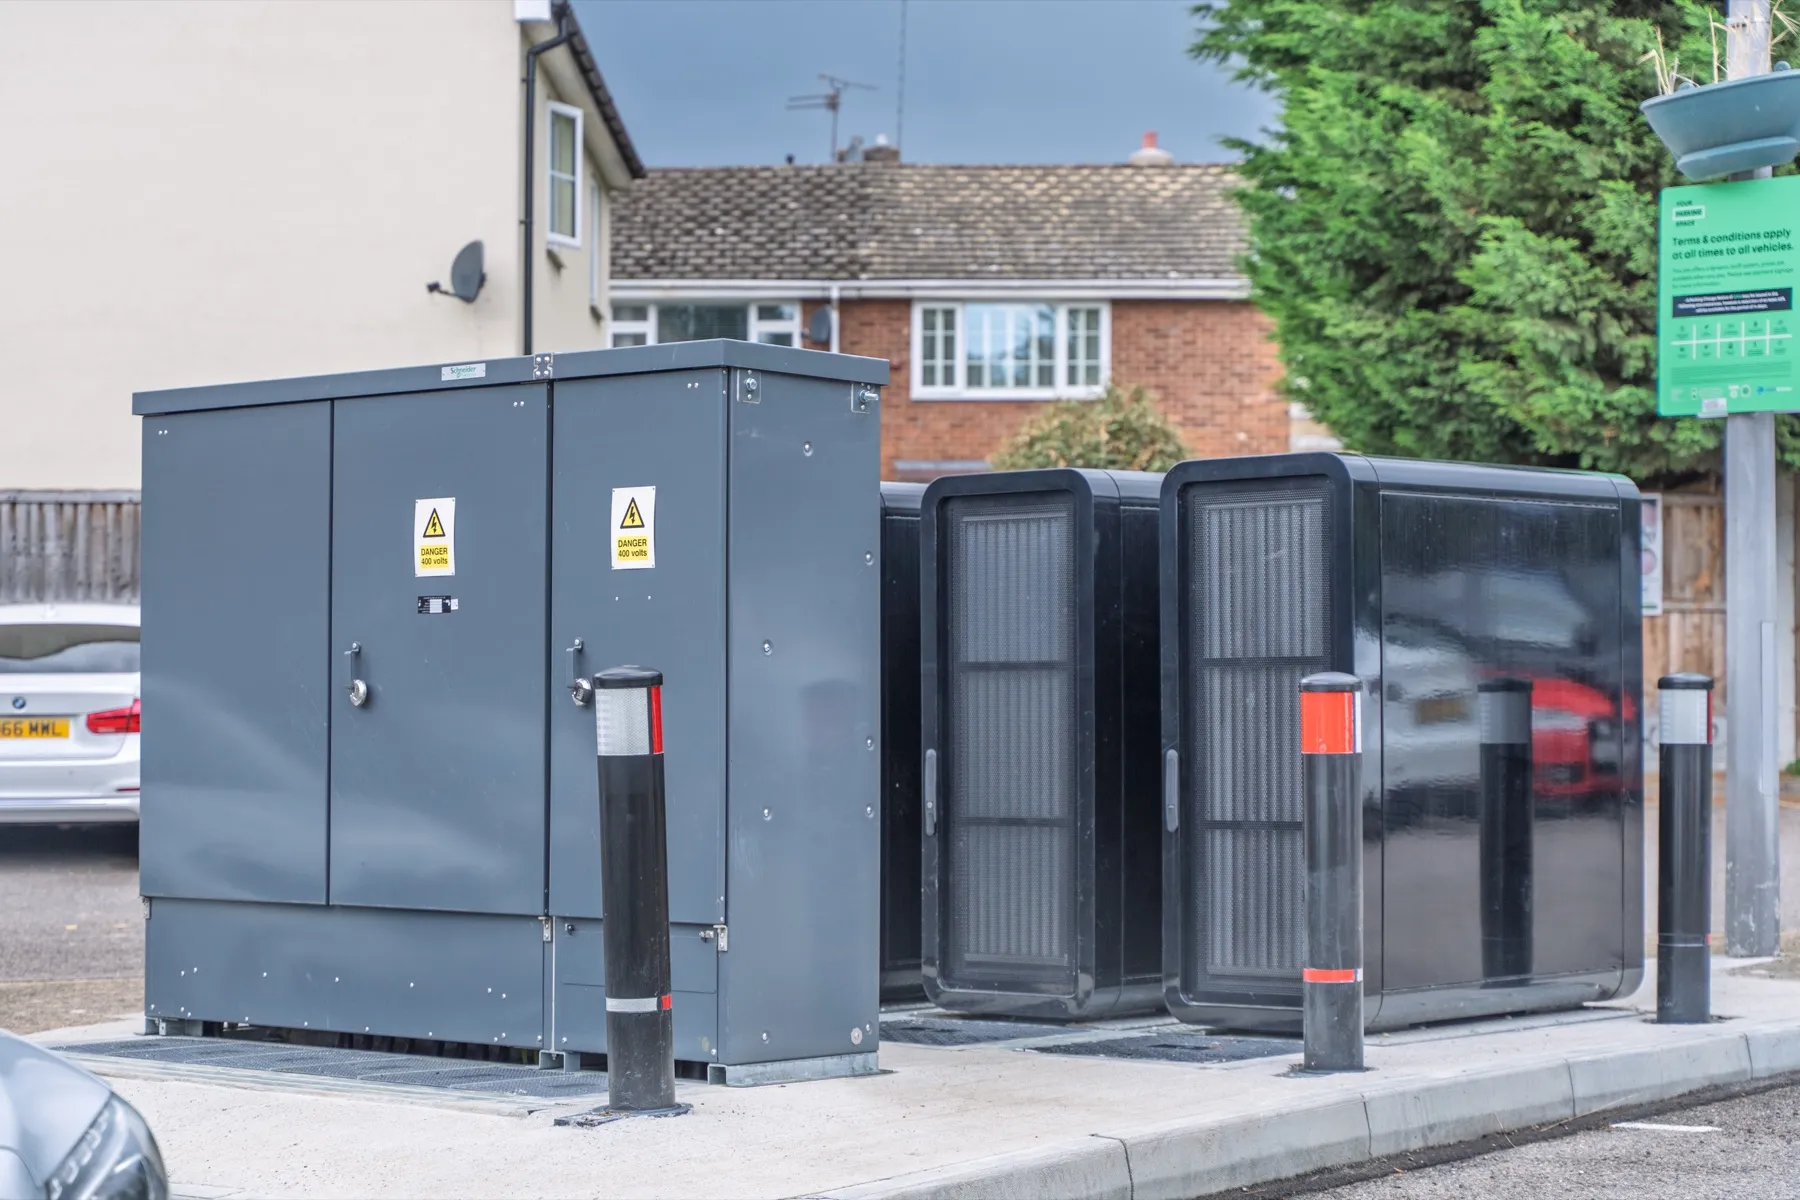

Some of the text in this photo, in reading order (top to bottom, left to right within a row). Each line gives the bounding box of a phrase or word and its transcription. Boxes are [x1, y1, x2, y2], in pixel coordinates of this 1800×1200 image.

[1672, 228, 1791, 246] Terms & conditions apply
[1672, 242, 1793, 260] at all times to all vehicles.
[450, 366, 476, 374] Schneider
[618, 539, 647, 547] DANGER
[421, 547, 448, 556] DANGER
[618, 549, 647, 557] 400 volts
[421, 557, 448, 565] 400 volts
